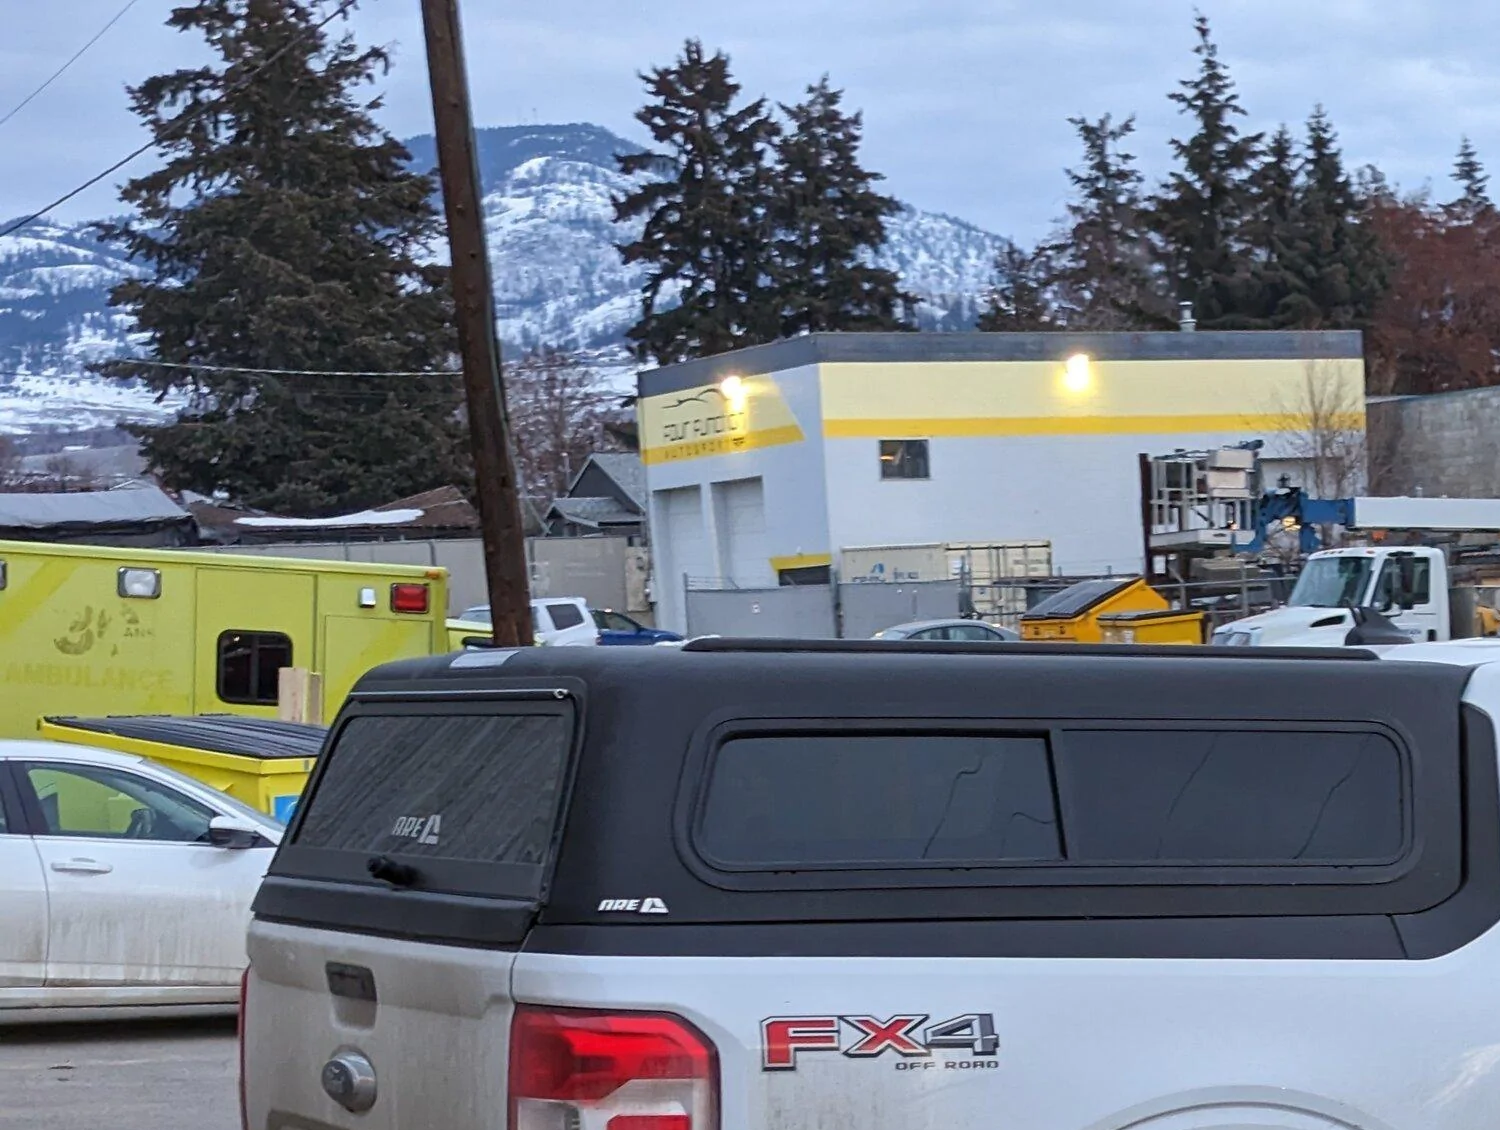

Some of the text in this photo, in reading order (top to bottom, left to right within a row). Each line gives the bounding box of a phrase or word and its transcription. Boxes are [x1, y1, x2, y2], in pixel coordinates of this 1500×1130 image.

[5, 662, 174, 692] AMBULANCE
[760, 1013, 1000, 1072] FX4
[895, 1060, 1000, 1071] OFF ROAD
